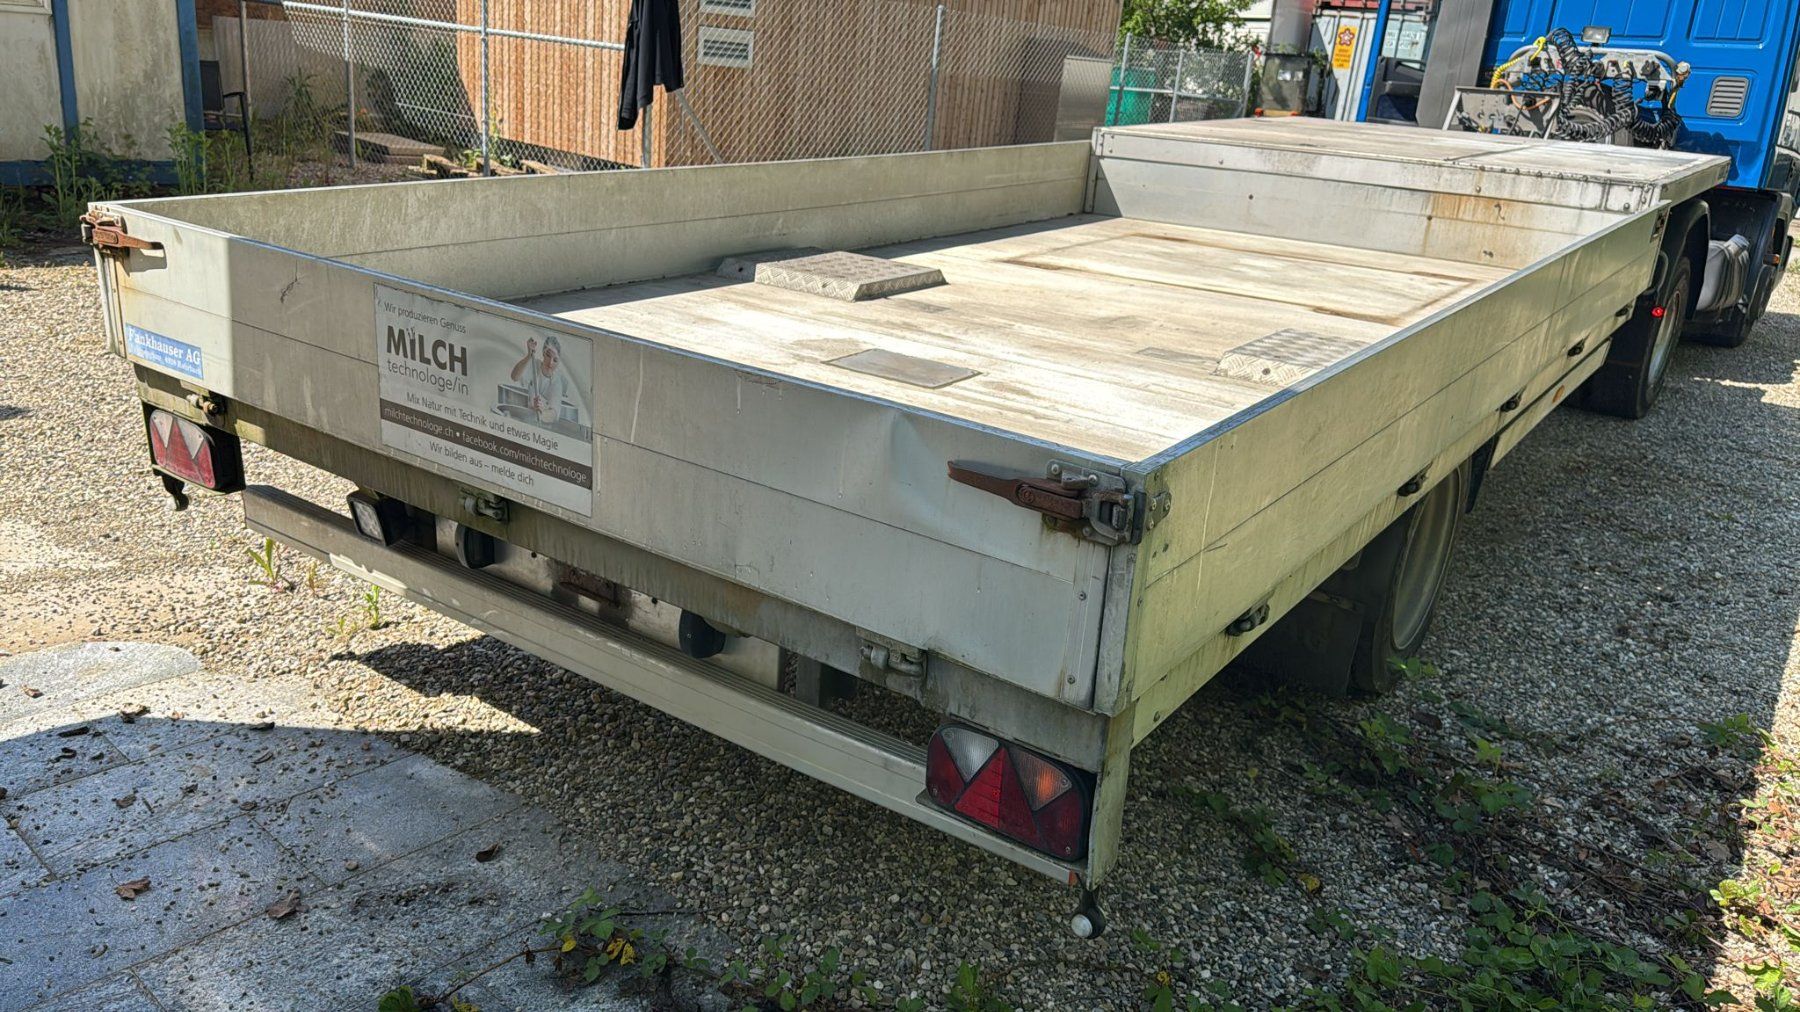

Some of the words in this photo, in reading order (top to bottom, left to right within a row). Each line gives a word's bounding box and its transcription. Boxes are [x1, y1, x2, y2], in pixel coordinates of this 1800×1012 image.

[384, 302, 396, 314] Wir
[398, 306, 438, 326] produzieren
[440, 318, 466, 334] Genuss
[128, 328, 184, 358] Fankhauser
[186, 348, 200, 364] AG
[387, 359, 468, 396] technologe/in
[407, 392, 420, 404] Mix
[422, 397, 442, 412] Natur
[444, 406, 456, 417] mit
[458, 408, 487, 425] Technik
[490, 420, 504, 432] und
[506, 426, 530, 441] etwas
[532, 432, 558, 450] Magie
[384, 408, 454, 437] milchtechnologe.ch
[462, 431, 587, 482] facebook.com/milchtechnologe
[430, 442, 442, 454] Wir
[444, 446, 468, 462] bilden
[470, 457, 483, 468] aus
[492, 463, 515, 480] melde
[518, 471, 534, 486] dich
